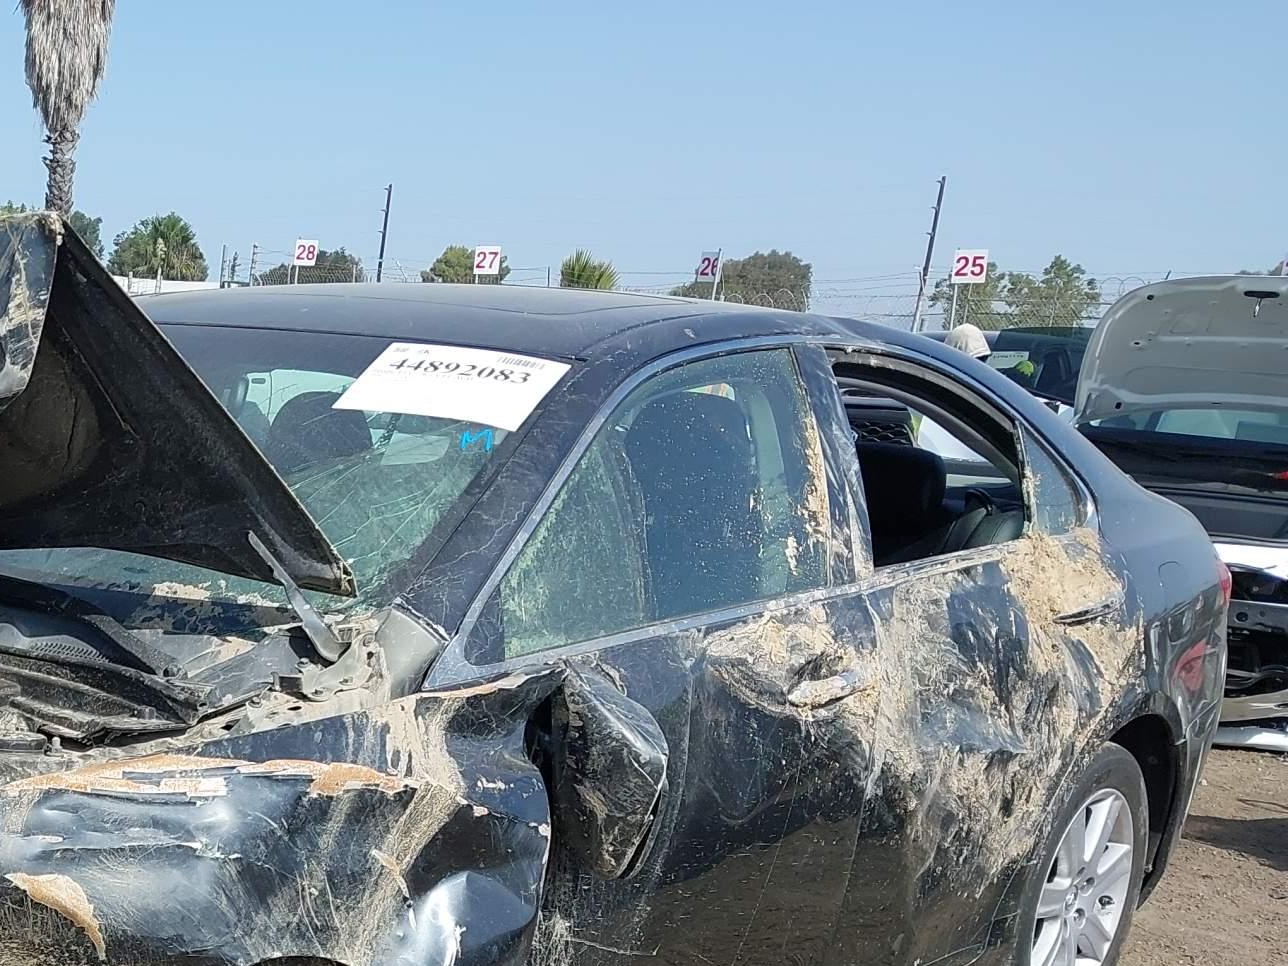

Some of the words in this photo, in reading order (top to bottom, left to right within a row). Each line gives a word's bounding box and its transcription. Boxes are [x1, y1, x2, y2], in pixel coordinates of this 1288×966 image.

[295, 245, 317, 261] 28
[475, 252, 499, 270] 27
[700, 257, 718, 276] 26
[954, 255, 986, 278] 25
[389, 357, 532, 384] 44892083
